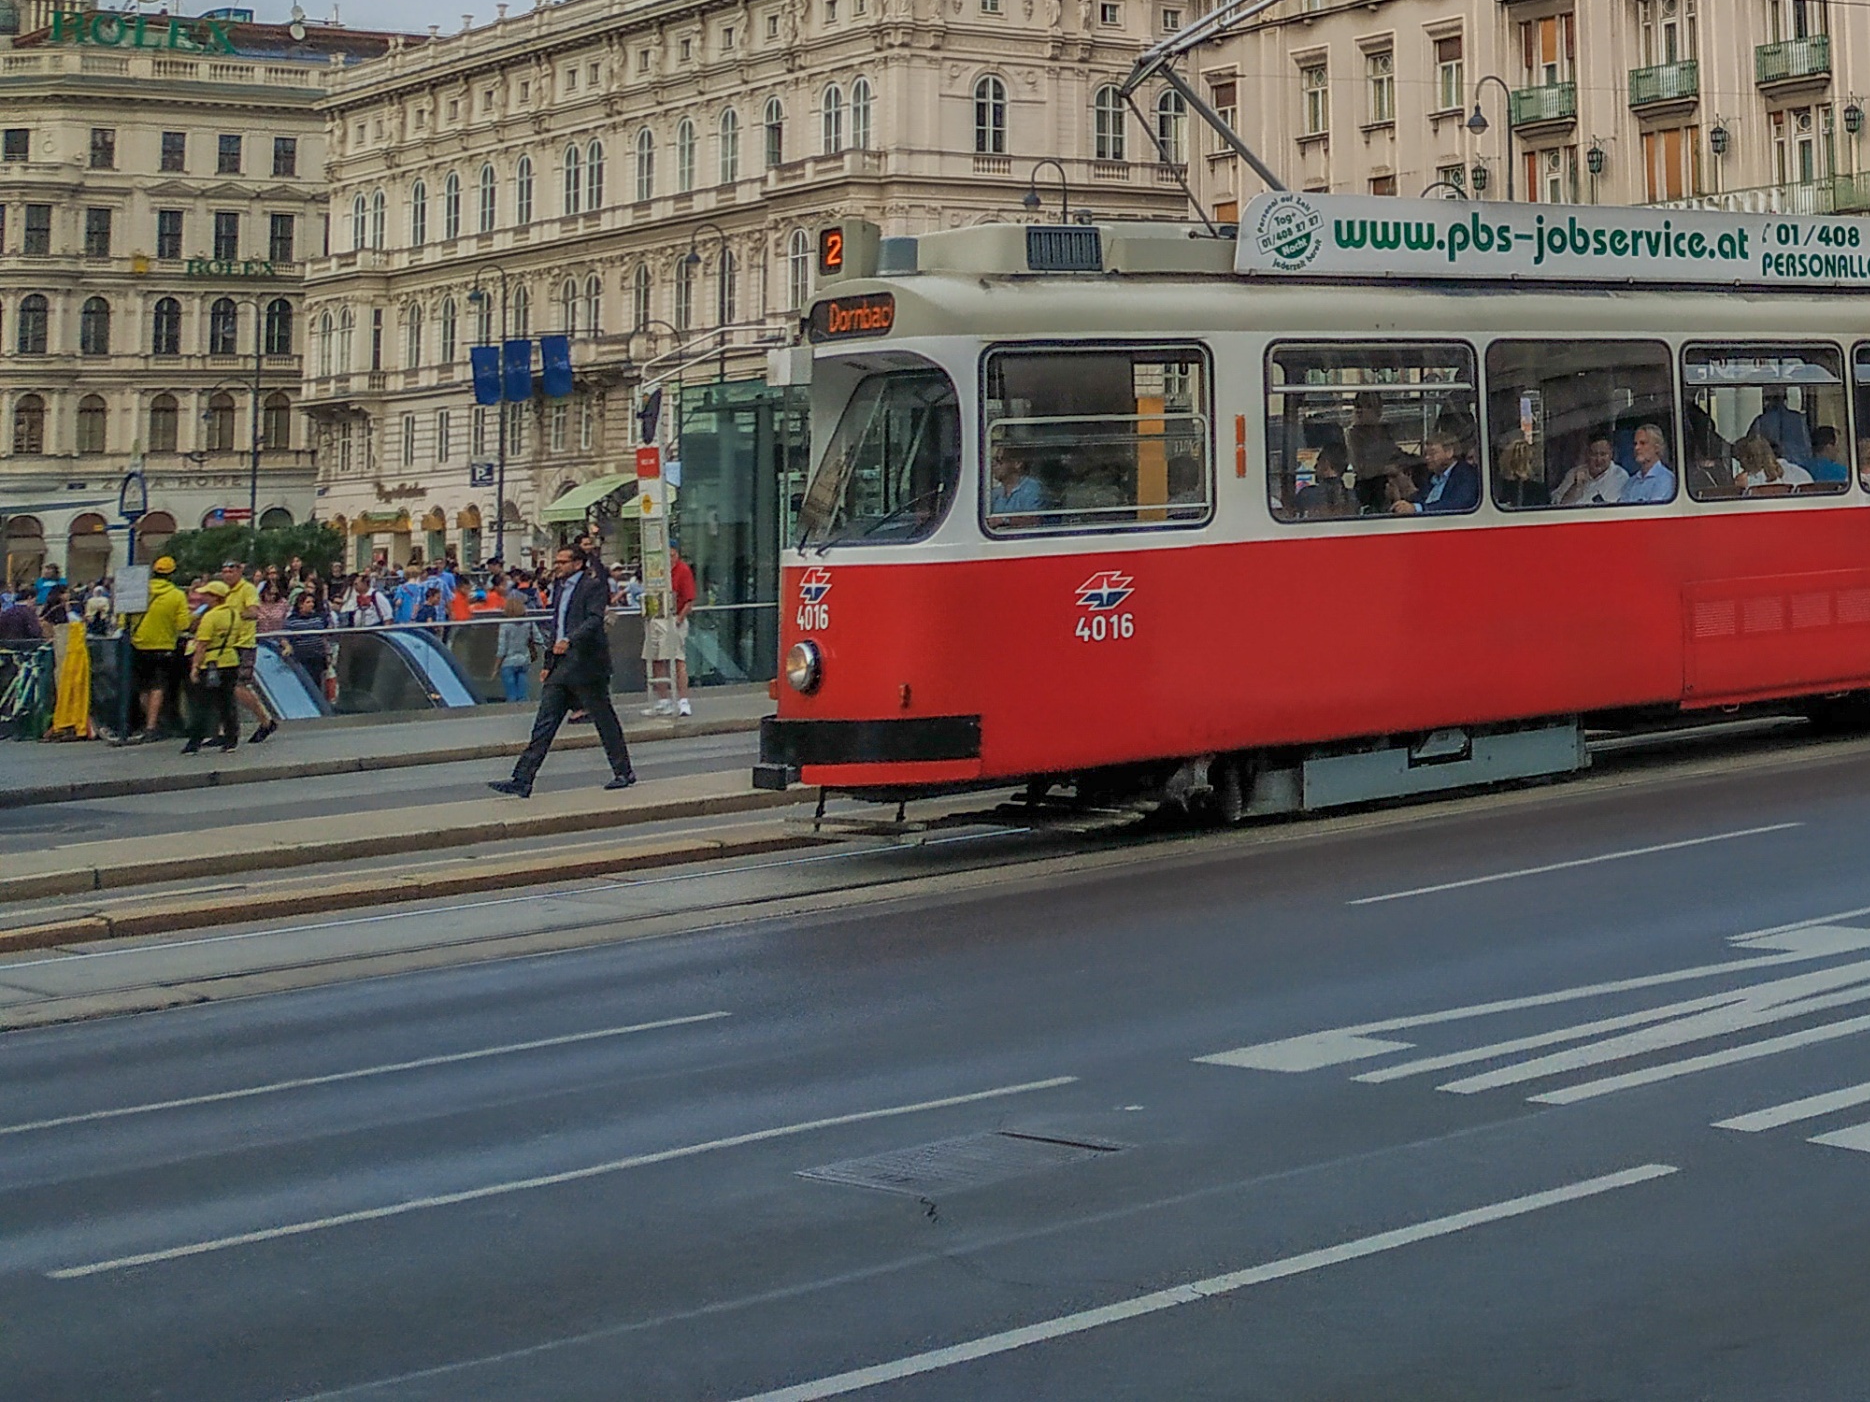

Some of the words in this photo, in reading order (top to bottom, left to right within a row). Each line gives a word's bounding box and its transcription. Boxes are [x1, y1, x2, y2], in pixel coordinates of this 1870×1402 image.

[50, 10, 238, 55] ROLEX
[1295, 221, 1306, 233] 27
[1308, 215, 1319, 226] 27
[826, 234, 842, 266] 2
[1281, 238, 1309, 256] Nacht
[1333, 211, 1750, 266] www.pbs-jobservice.at
[187, 260, 275, 276] ROLEX
[177, 475, 242, 487] HOME
[796, 604, 829, 631] 4016
[1075, 612, 1135, 642] 4016
